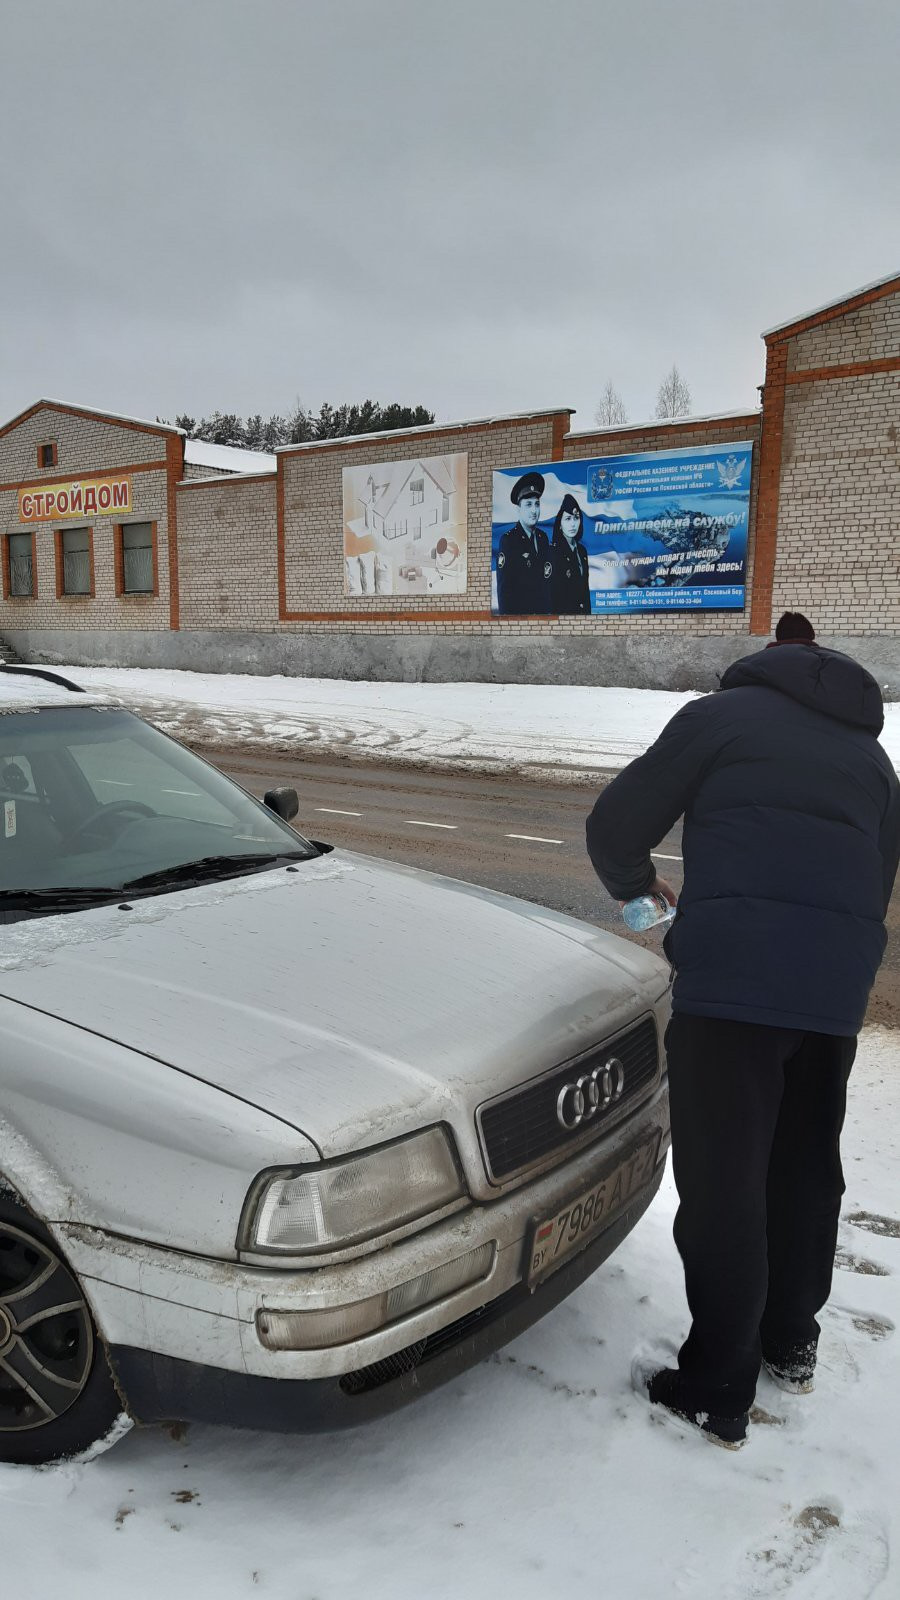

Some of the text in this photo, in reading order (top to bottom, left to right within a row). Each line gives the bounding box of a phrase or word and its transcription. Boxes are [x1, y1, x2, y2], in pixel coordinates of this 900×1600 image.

[614, 462, 715, 478] ФЕДЕРАЛЬНОЕ КАЗЕННОЕ УЧРЕЖДЕНИЕ
[614, 487, 633, 495] УФСИН
[633, 485, 652, 493] России
[660, 483, 688, 491] Псковской
[22, 481, 128, 518] СТРОЙДОМ
[594, 512, 746, 534] Приглашаем на службу!
[631, 555, 656, 566] чужды
[657, 551, 684, 562] отвага
[693, 549, 718, 559] честь
[656, 567, 669, 576] мы
[694, 562, 715, 573] тебя
[716, 561, 744, 573] здесь!
[532, 1250, 547, 1270] BY
[553, 1184, 607, 1257] 7986
